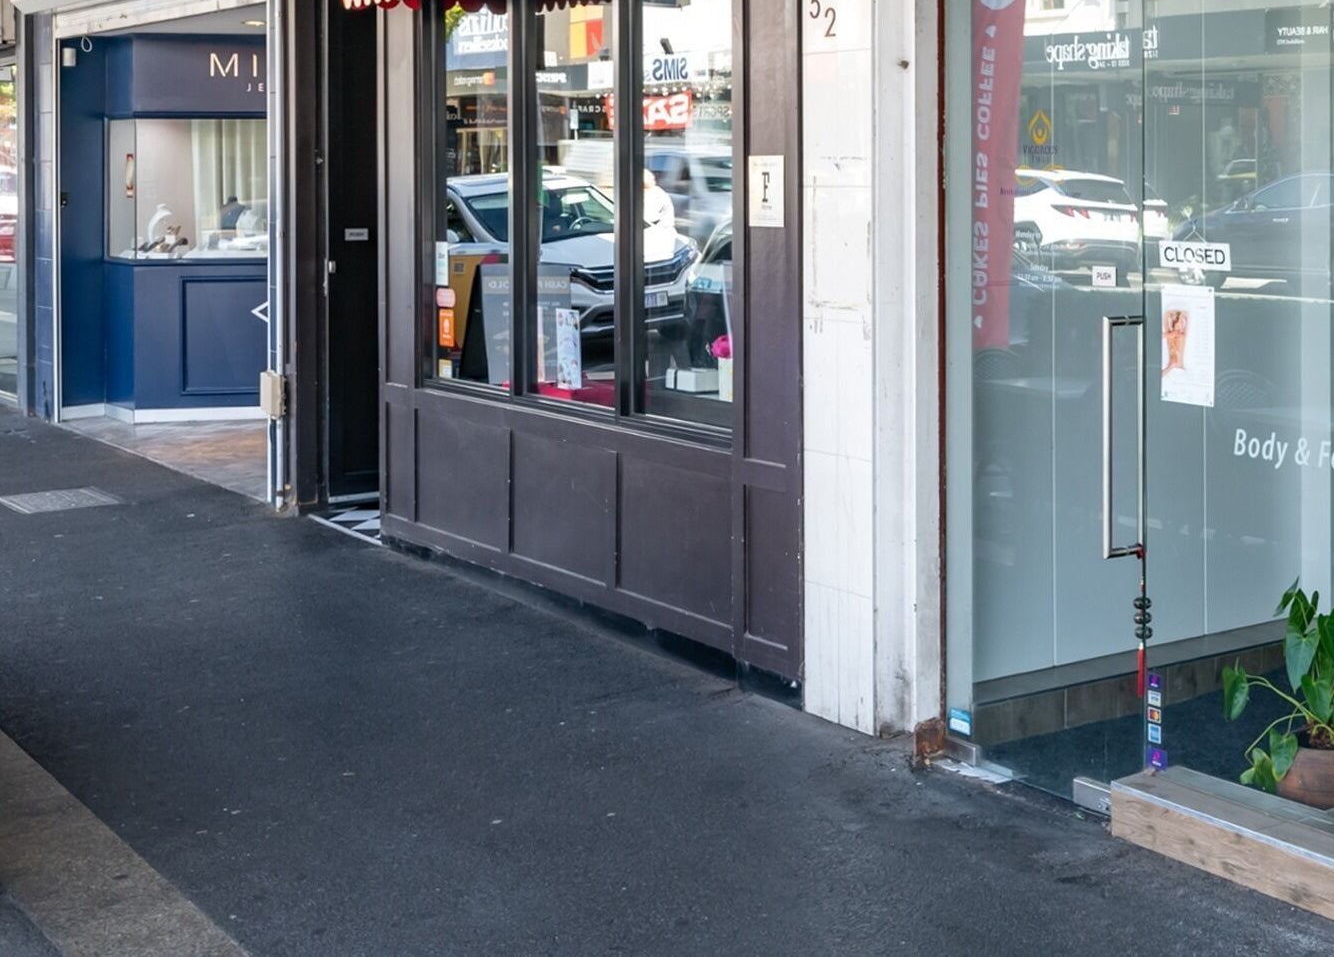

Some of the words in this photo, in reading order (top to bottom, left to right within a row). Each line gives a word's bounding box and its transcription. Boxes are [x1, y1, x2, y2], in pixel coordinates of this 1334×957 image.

[1163, 246, 1226, 265] CLOSED
[1096, 272, 1112, 280] PUSH
[1233, 428, 1288, 469] Body
[1294, 437, 1310, 466] &
